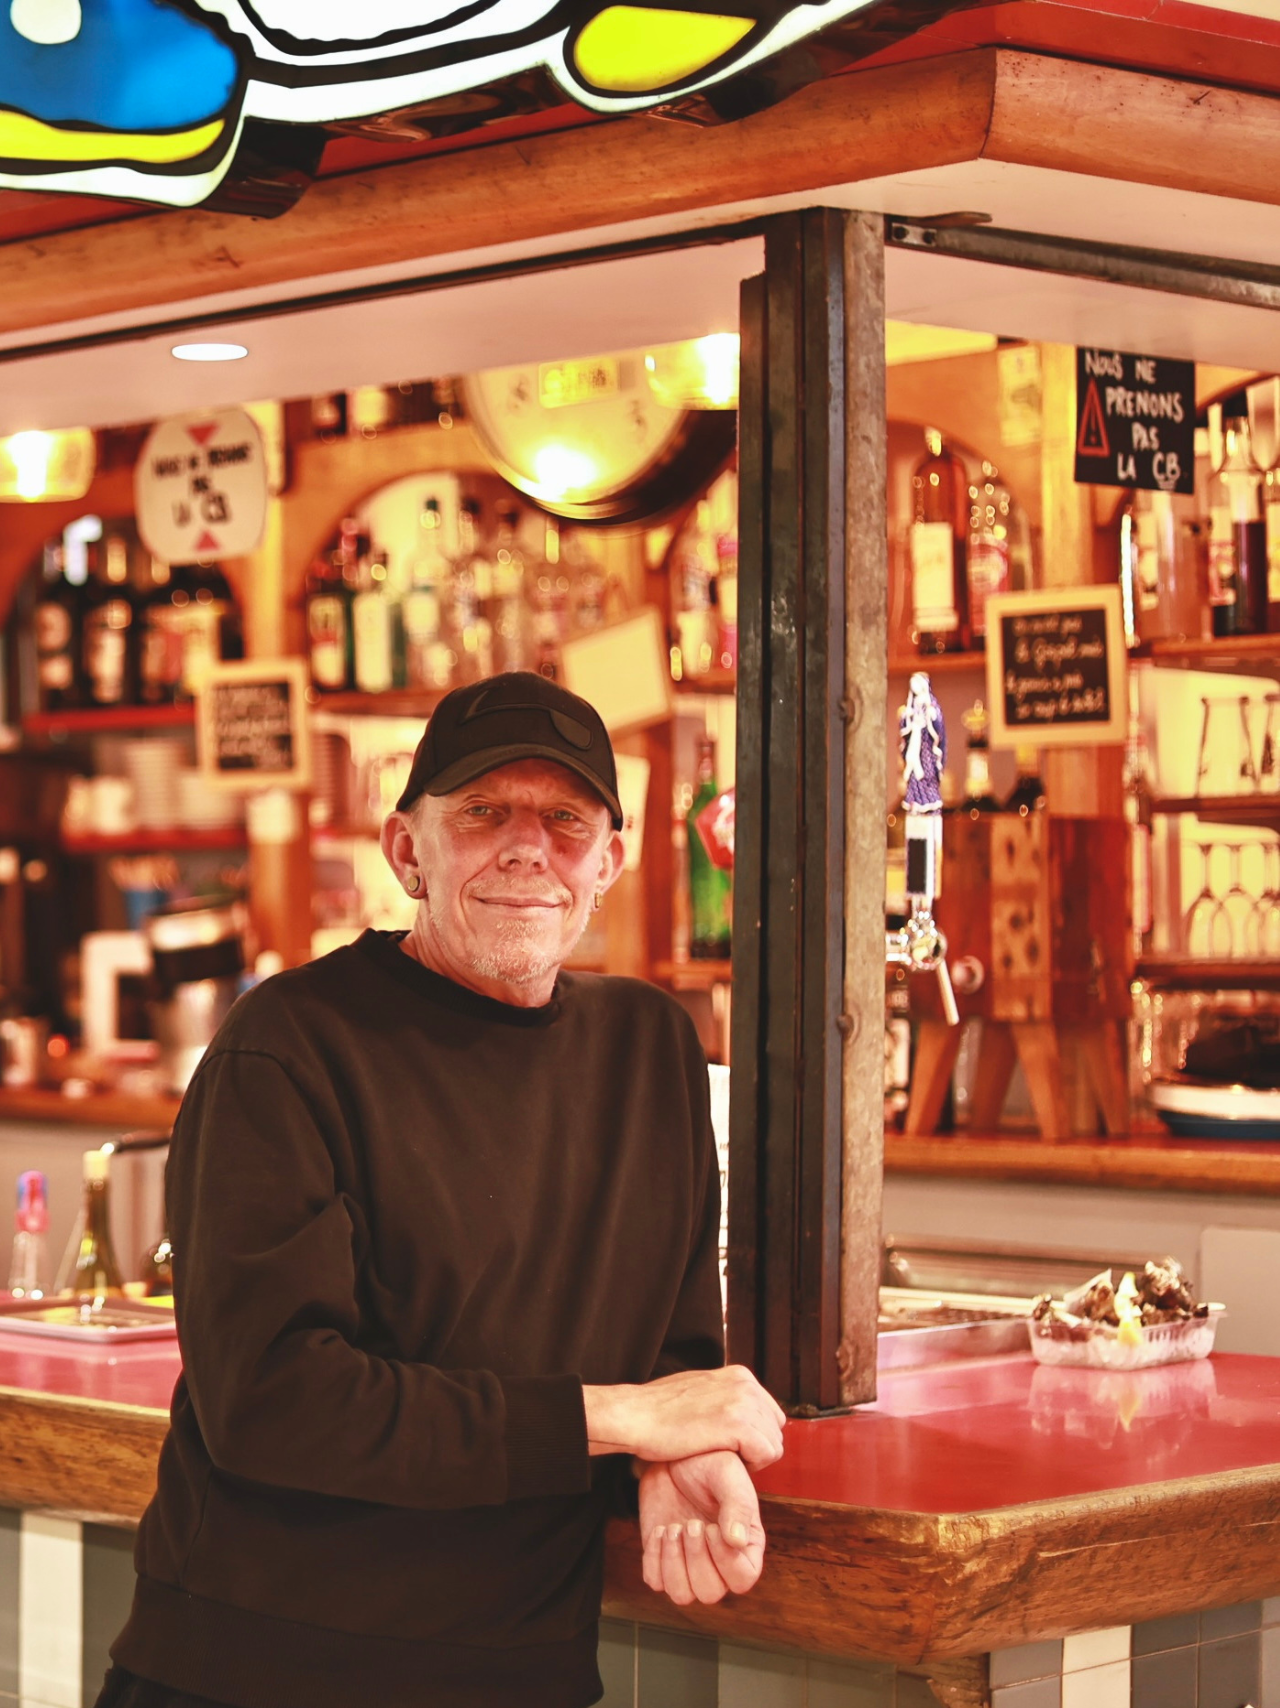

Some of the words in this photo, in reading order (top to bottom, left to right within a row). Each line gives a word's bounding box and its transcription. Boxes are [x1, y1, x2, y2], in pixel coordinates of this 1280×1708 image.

[1085, 350, 1124, 381] NOUS
[1135, 358, 1157, 385] NE
[1105, 386, 1185, 424] PRENONS
[1131, 421, 1160, 451] PAS
[1117, 451, 1137, 482] LA
[1152, 451, 1182, 484] CB
